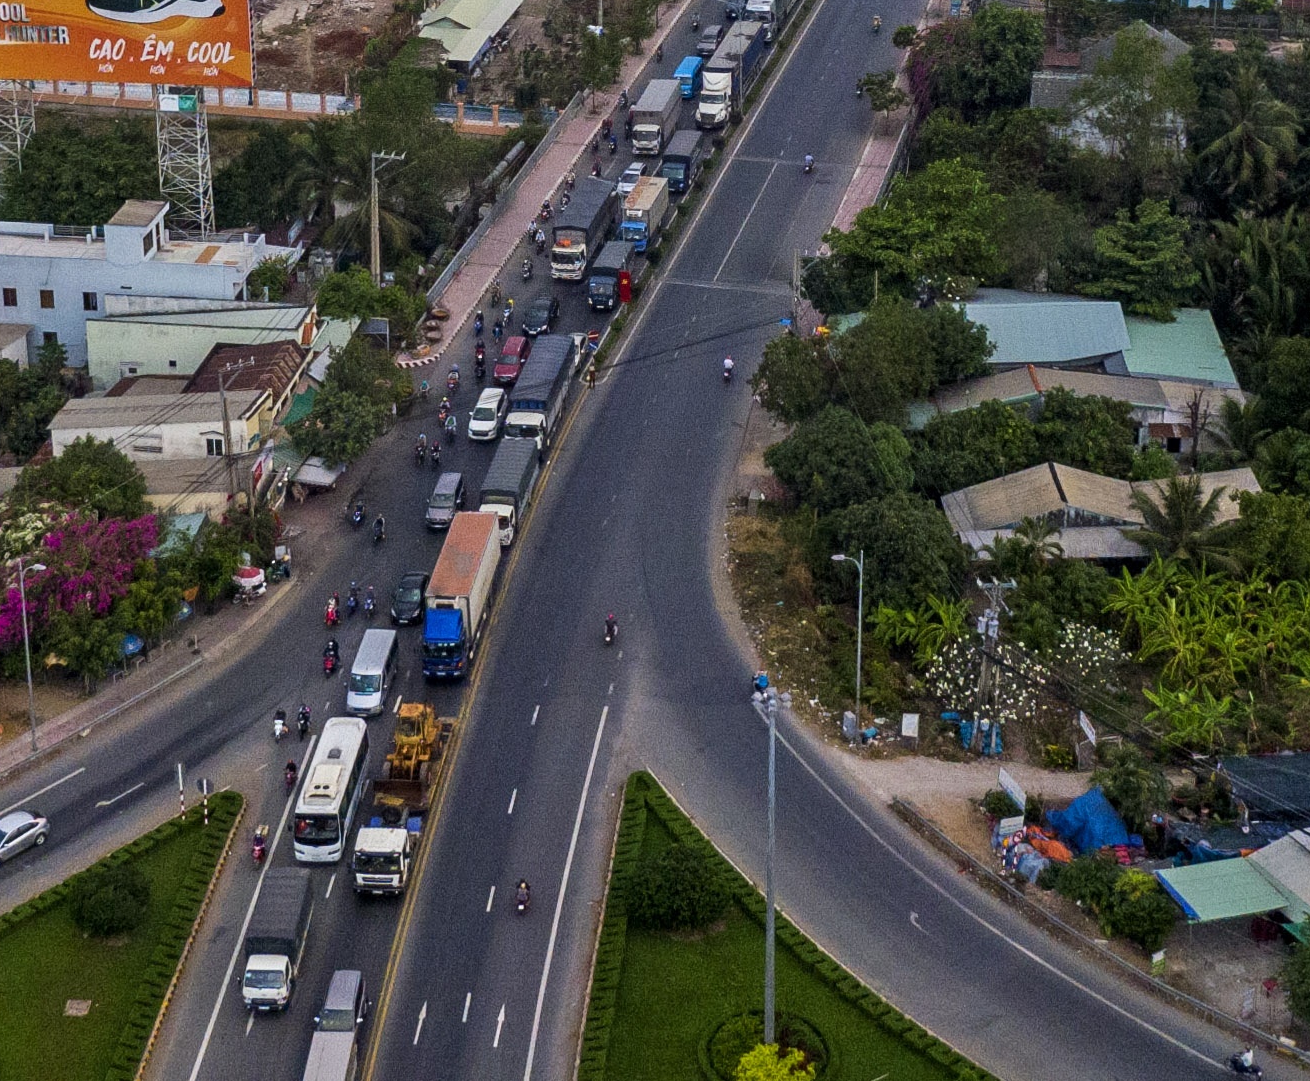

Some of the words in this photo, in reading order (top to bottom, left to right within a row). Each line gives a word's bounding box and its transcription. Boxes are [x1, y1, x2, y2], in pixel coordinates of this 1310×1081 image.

[4, 25, 70, 45] HUNTER
[89, 38, 126, 61] CAO
[140, 33, 175, 62] ÊM
[187, 41, 235, 64] COOL
